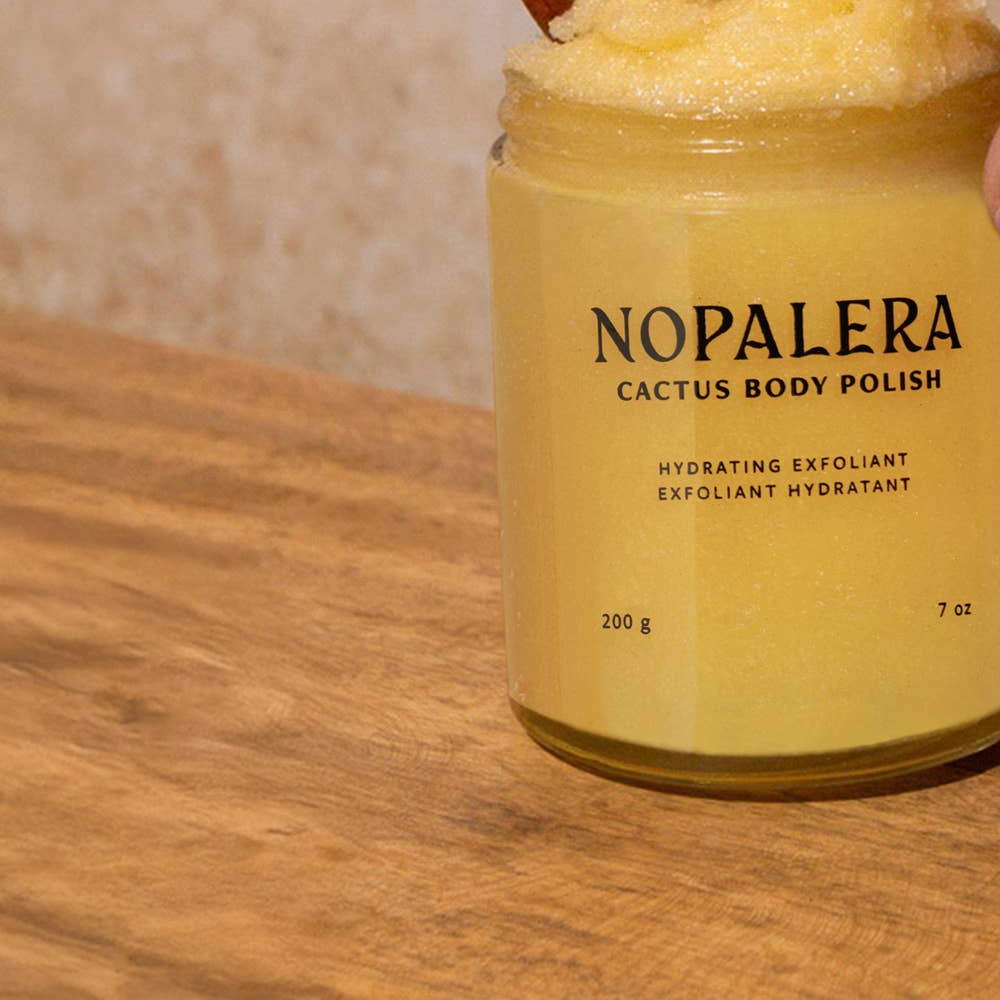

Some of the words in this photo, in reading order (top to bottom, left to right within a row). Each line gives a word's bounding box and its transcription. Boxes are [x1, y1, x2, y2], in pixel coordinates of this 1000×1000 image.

[590, 294, 963, 363] NOPALERA
[616, 379, 731, 402] CACTUS
[744, 375, 828, 399] BODY
[840, 368, 942, 395] POLISH
[658, 458, 781, 476] HYDRATING
[792, 452, 909, 473] EXFOLIANT
[658, 484, 777, 501] EXFOLIANT
[787, 476, 911, 498] HYDRATANT
[937, 601, 948, 618] 7
[953, 602, 972, 617] oz
[601, 613, 633, 630] 200
[640, 617, 652, 635] g
